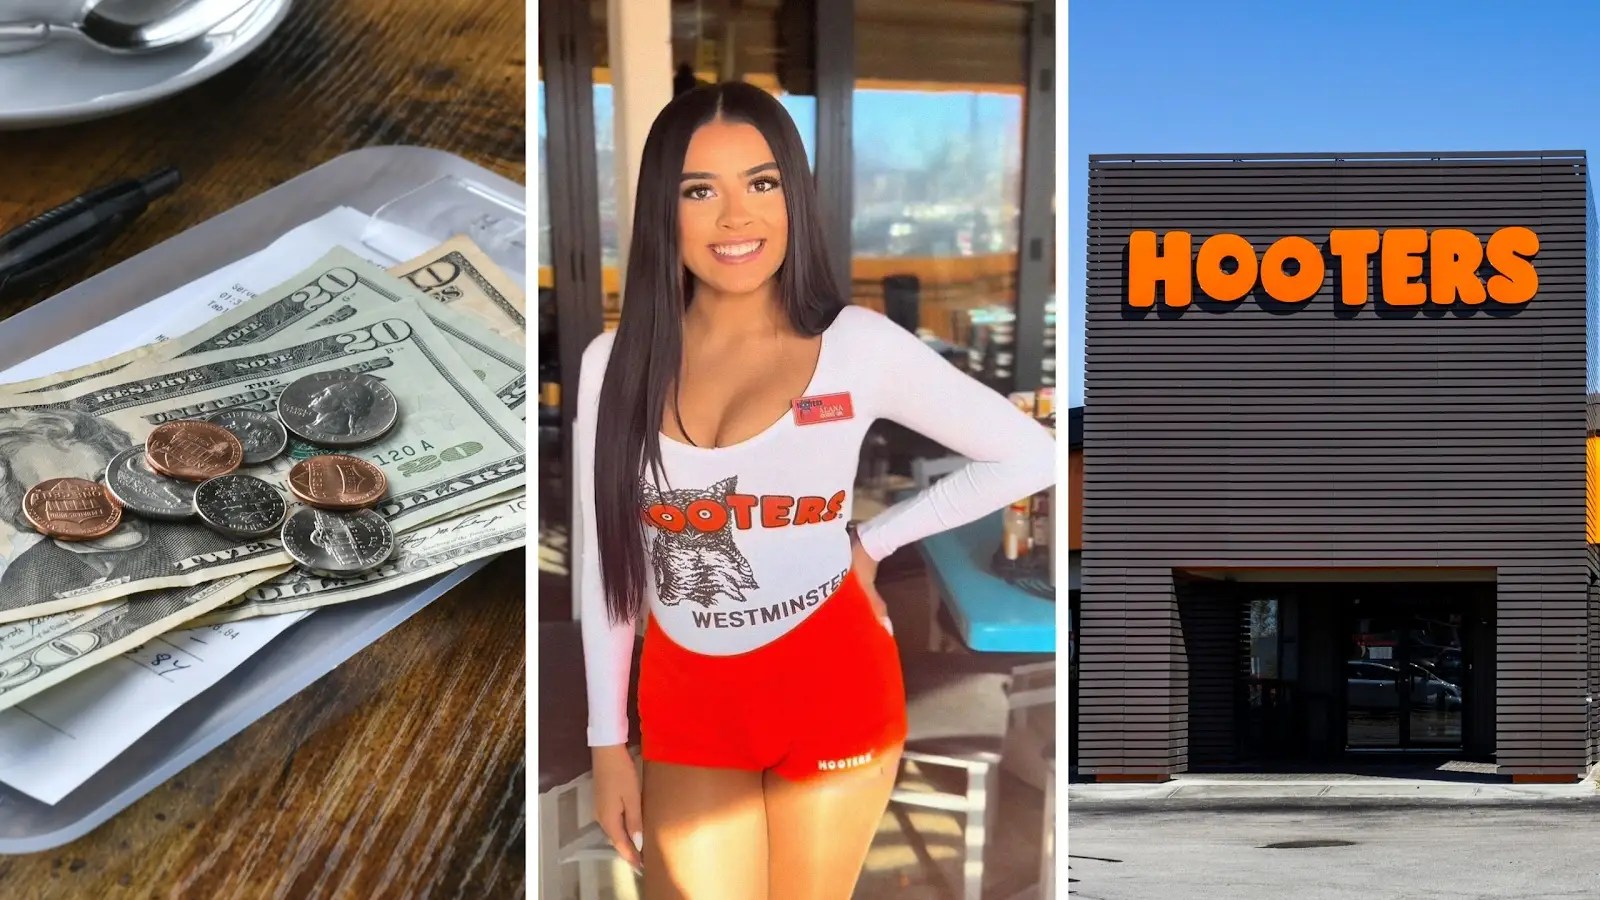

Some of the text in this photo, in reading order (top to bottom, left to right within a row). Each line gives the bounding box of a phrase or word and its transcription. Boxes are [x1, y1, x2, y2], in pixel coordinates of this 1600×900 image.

[1127, 226, 1540, 307] HOOTERS
[219, 292, 242, 306] 01:3
[232, 283, 257, 299] Serve
[291, 267, 358, 311] 20
[207, 300, 229, 313] Tabl
[215, 319, 264, 348] NOTE
[335, 318, 413, 355] 20
[97, 353, 293, 404] RESERVE NOTE
[244, 378, 280, 390] THE
[373, 445, 416, 466] 120
